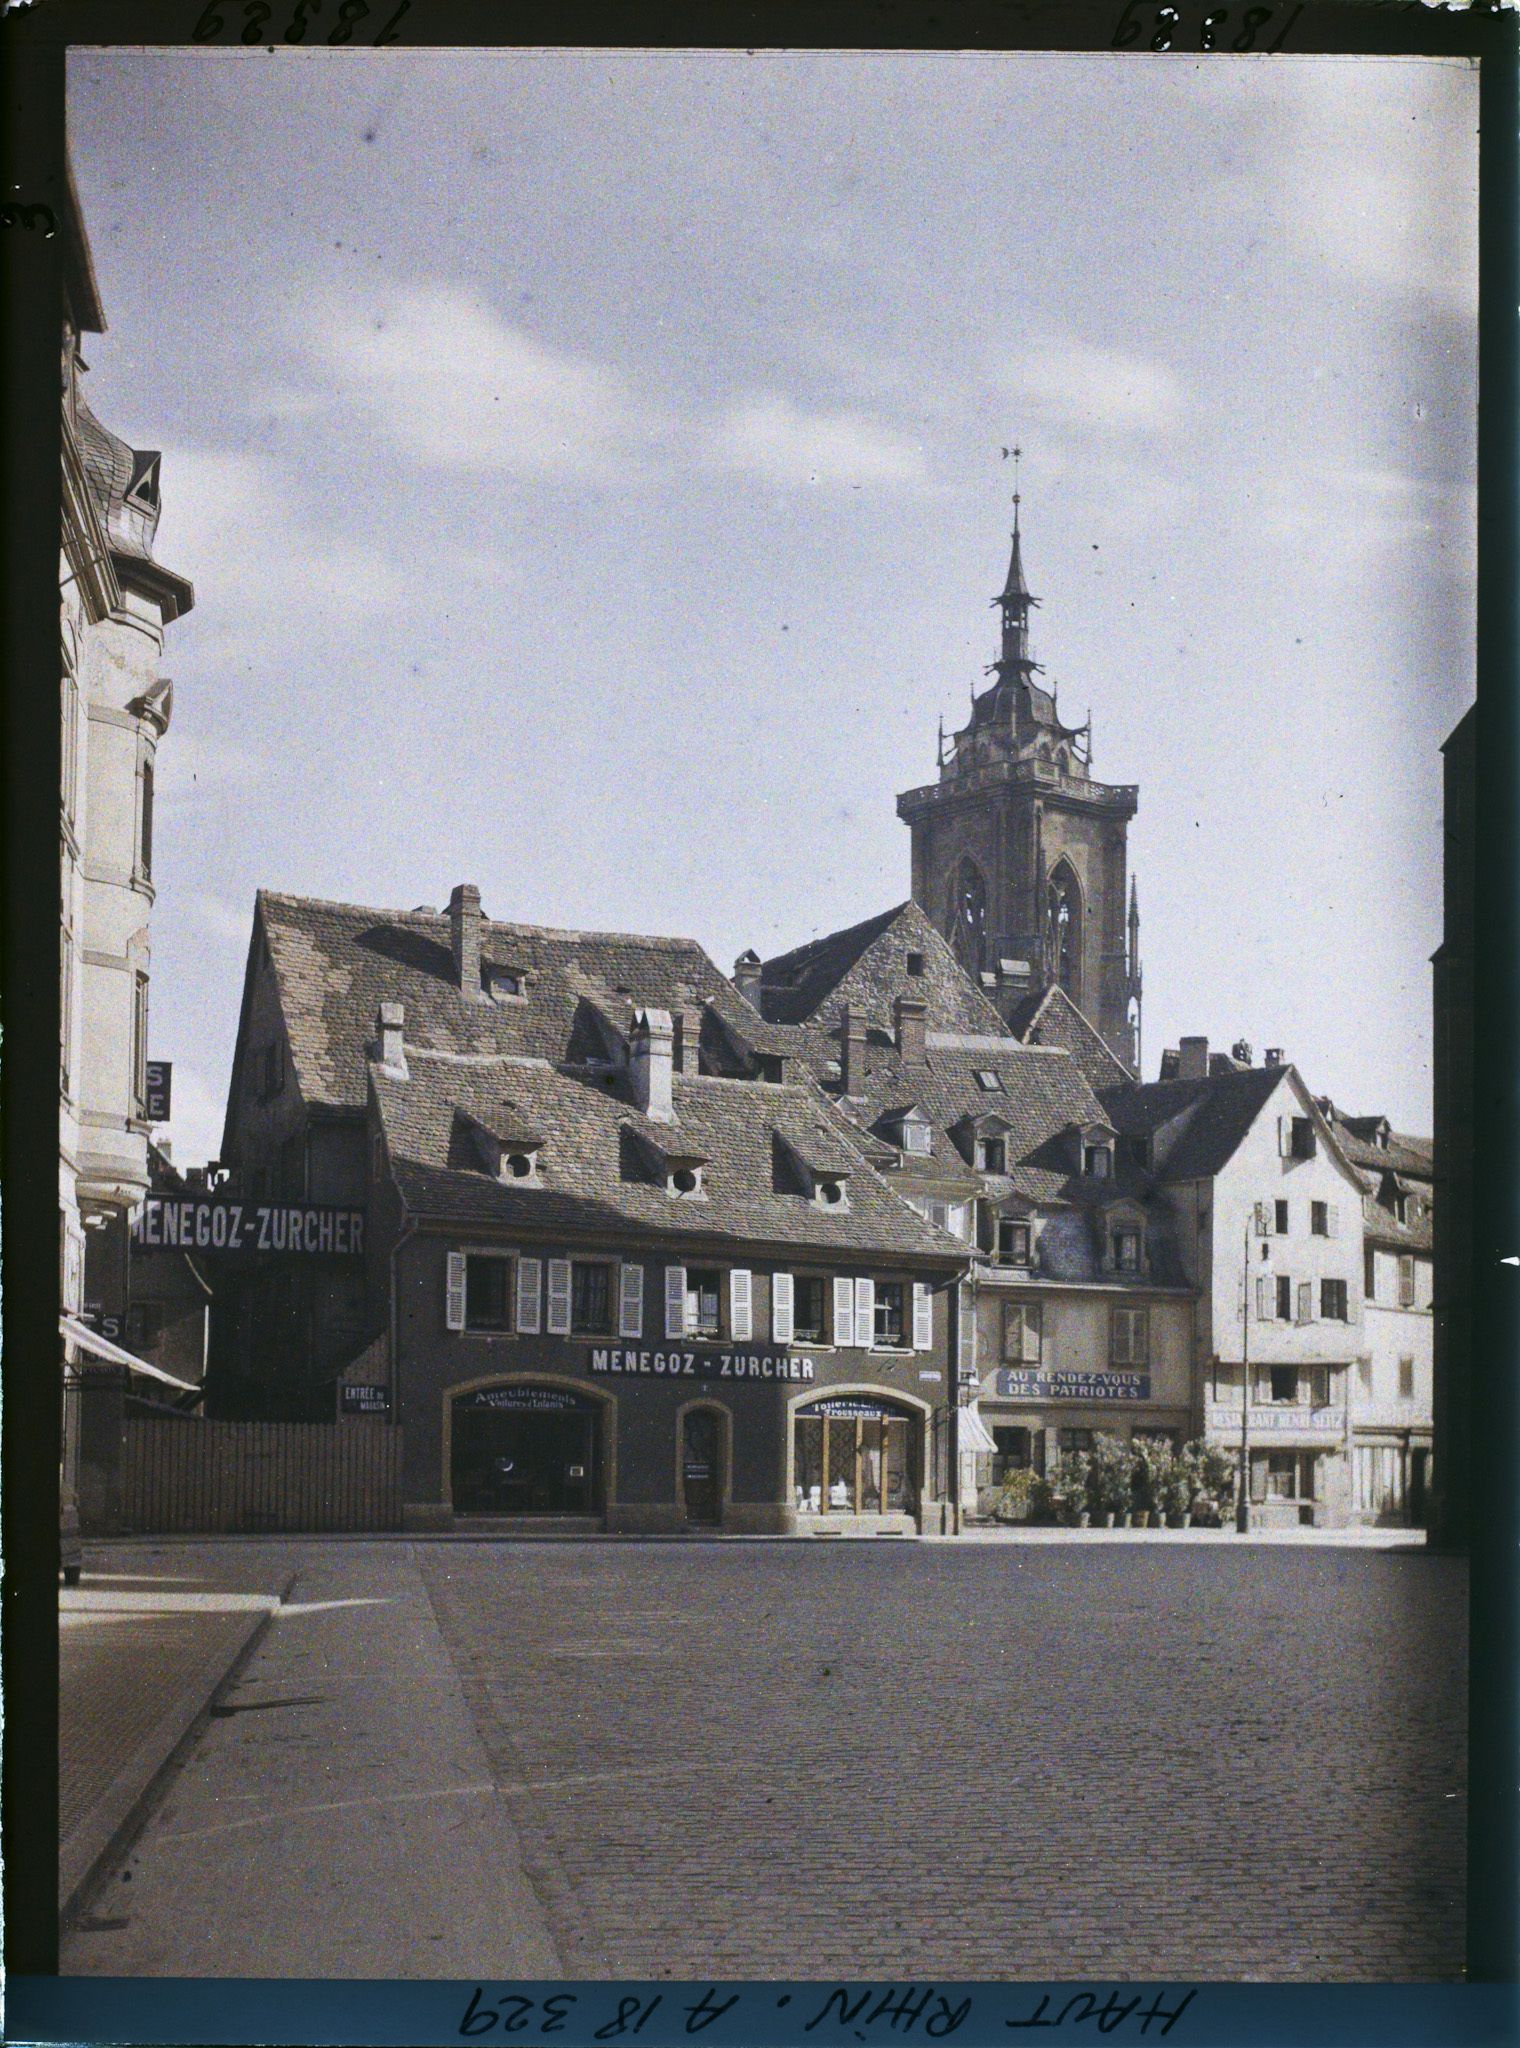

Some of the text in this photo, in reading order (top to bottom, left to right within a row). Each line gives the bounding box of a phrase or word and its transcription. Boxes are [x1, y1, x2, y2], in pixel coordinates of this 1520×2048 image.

[127, 1200, 363, 1254] MENEGOZ-ZURCHER
[592, 1349, 695, 1375] MENEGOZ
[720, 1355, 814, 1379] ZURCHER
[1007, 1371, 1141, 1386] AU RENDEZ-VOUS
[1009, 1383, 1138, 1398] DES PATRIOTES
[475, 1387, 576, 1406] Ameublements
[825, 1408, 882, 1418] Trousseaux
[684, 1986, 739, 2036] A
[1005, 1986, 1200, 2036] HAUT
